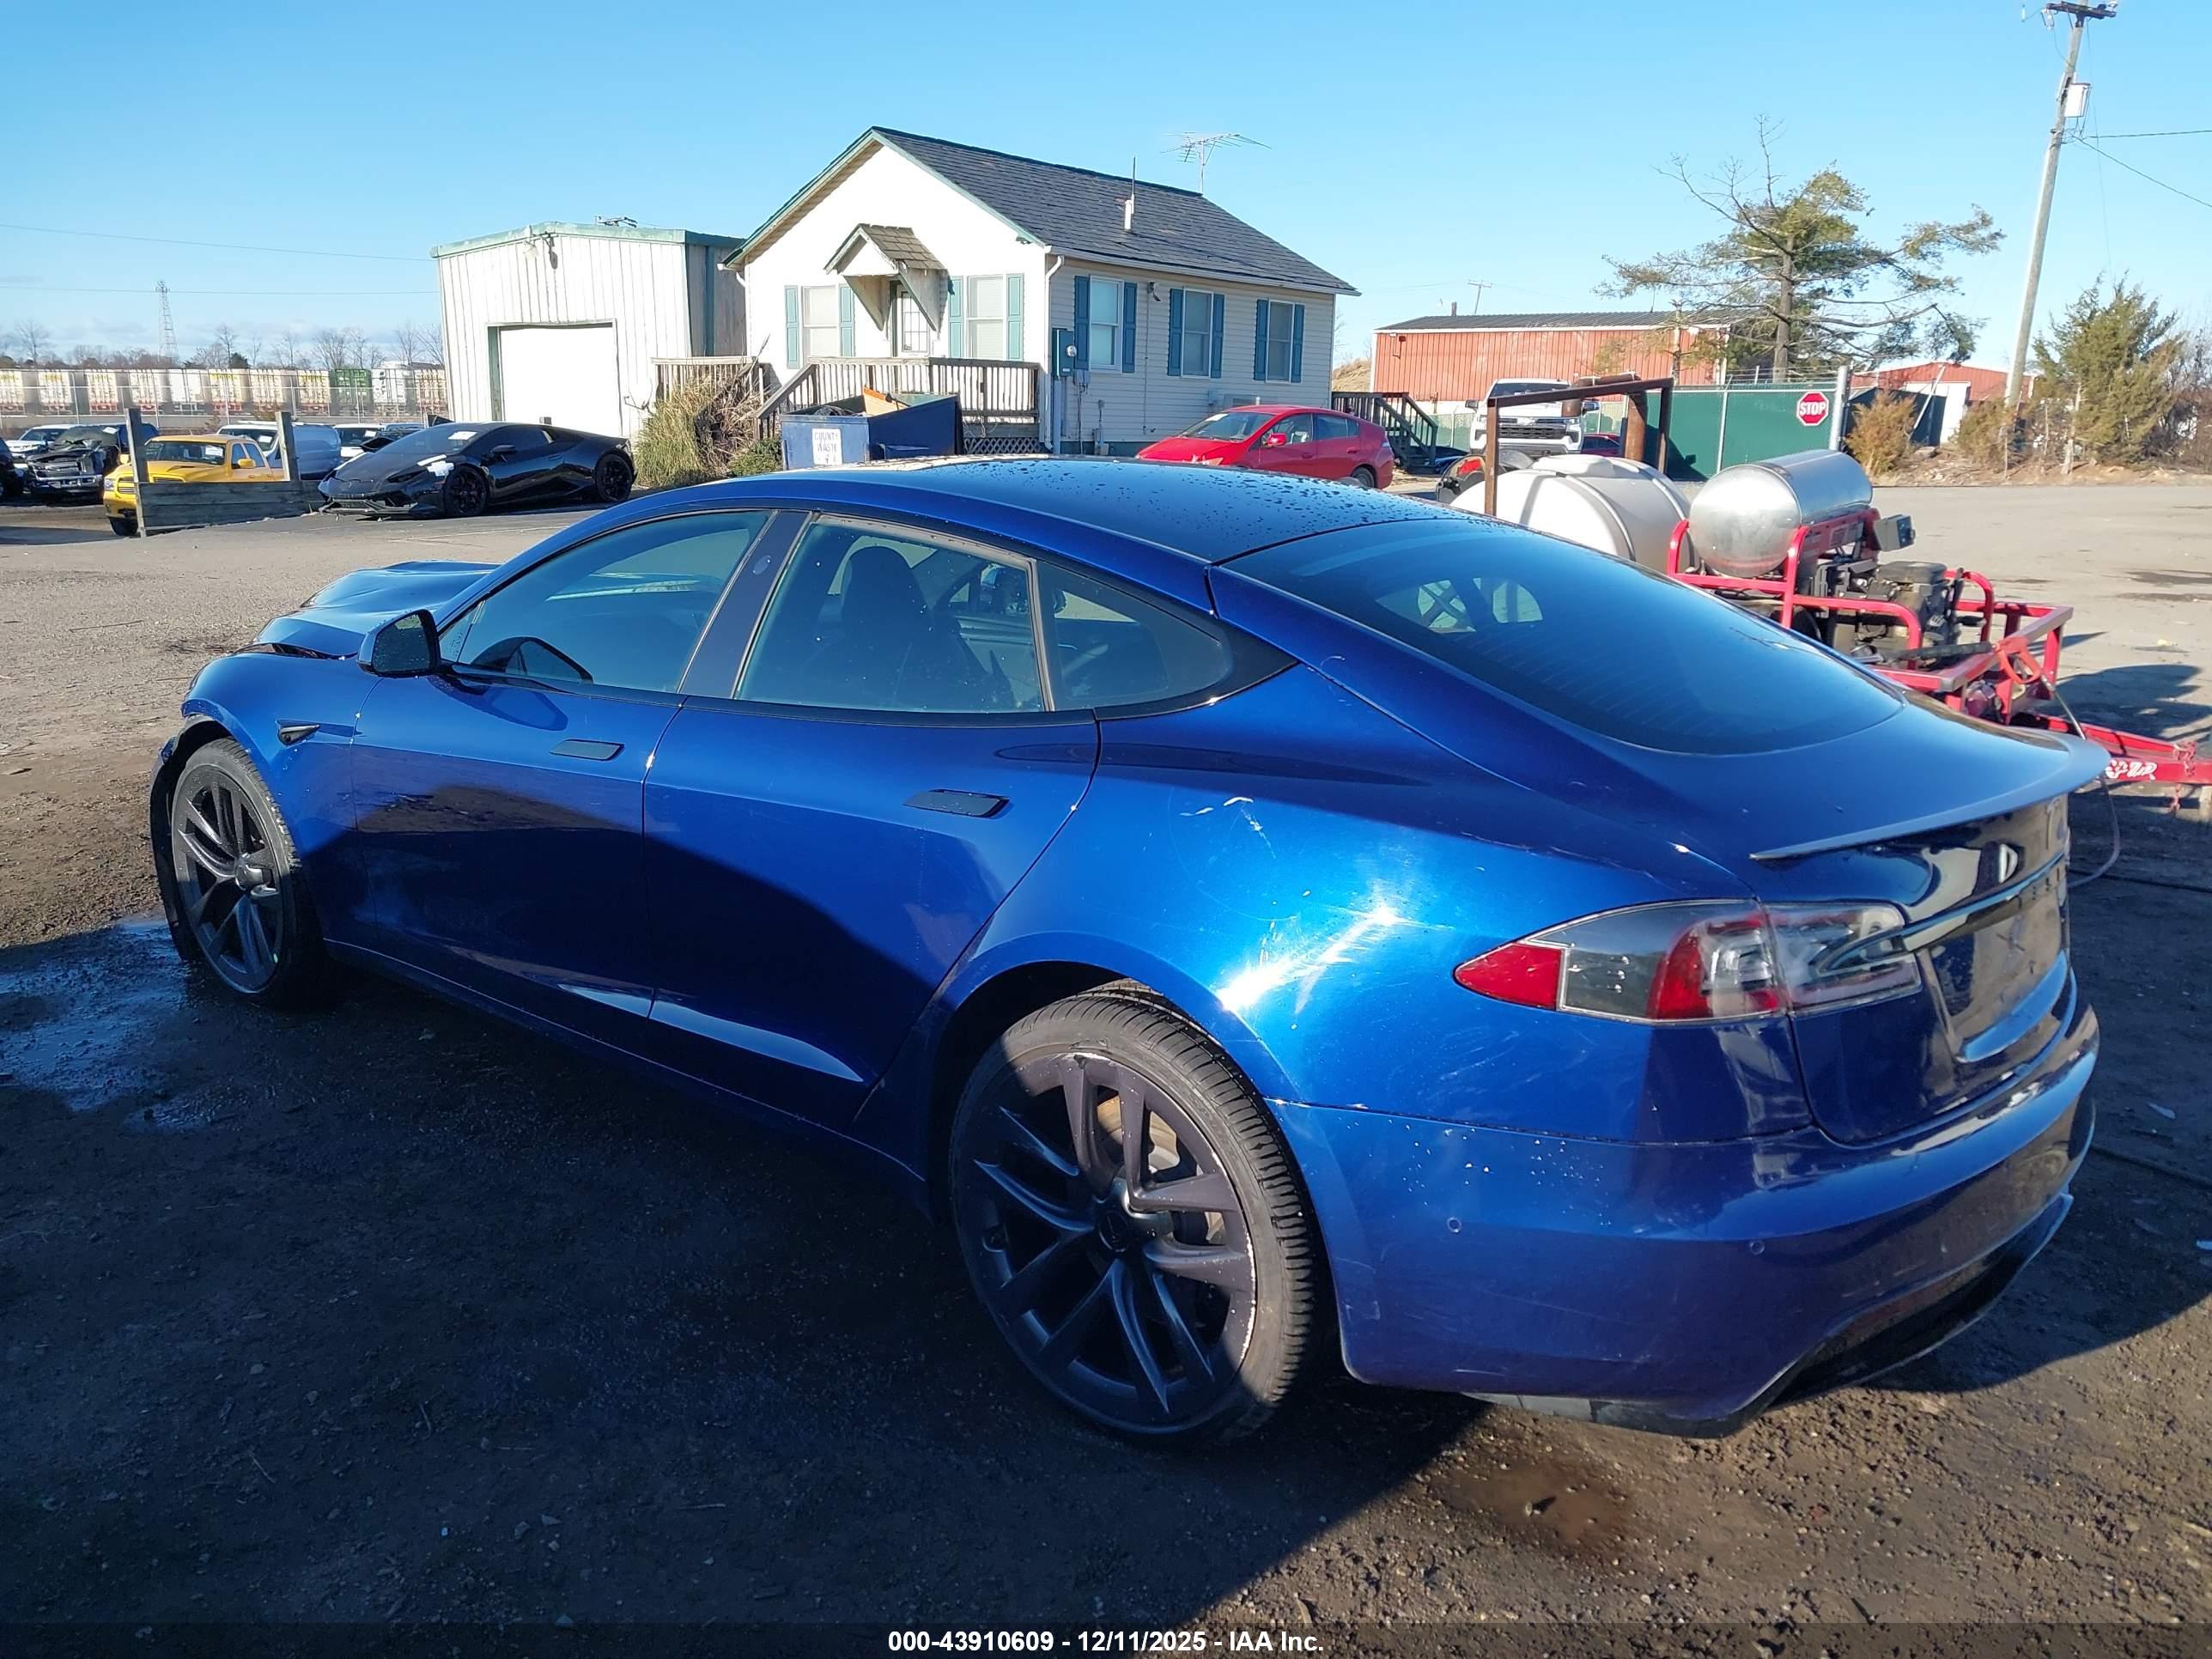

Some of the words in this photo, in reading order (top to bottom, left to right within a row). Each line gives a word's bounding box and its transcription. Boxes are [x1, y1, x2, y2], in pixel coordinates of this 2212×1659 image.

[1800, 401, 1826, 416] STOP
[814, 432, 839, 441] COUNTY
[817, 442, 838, 453] WASTE
